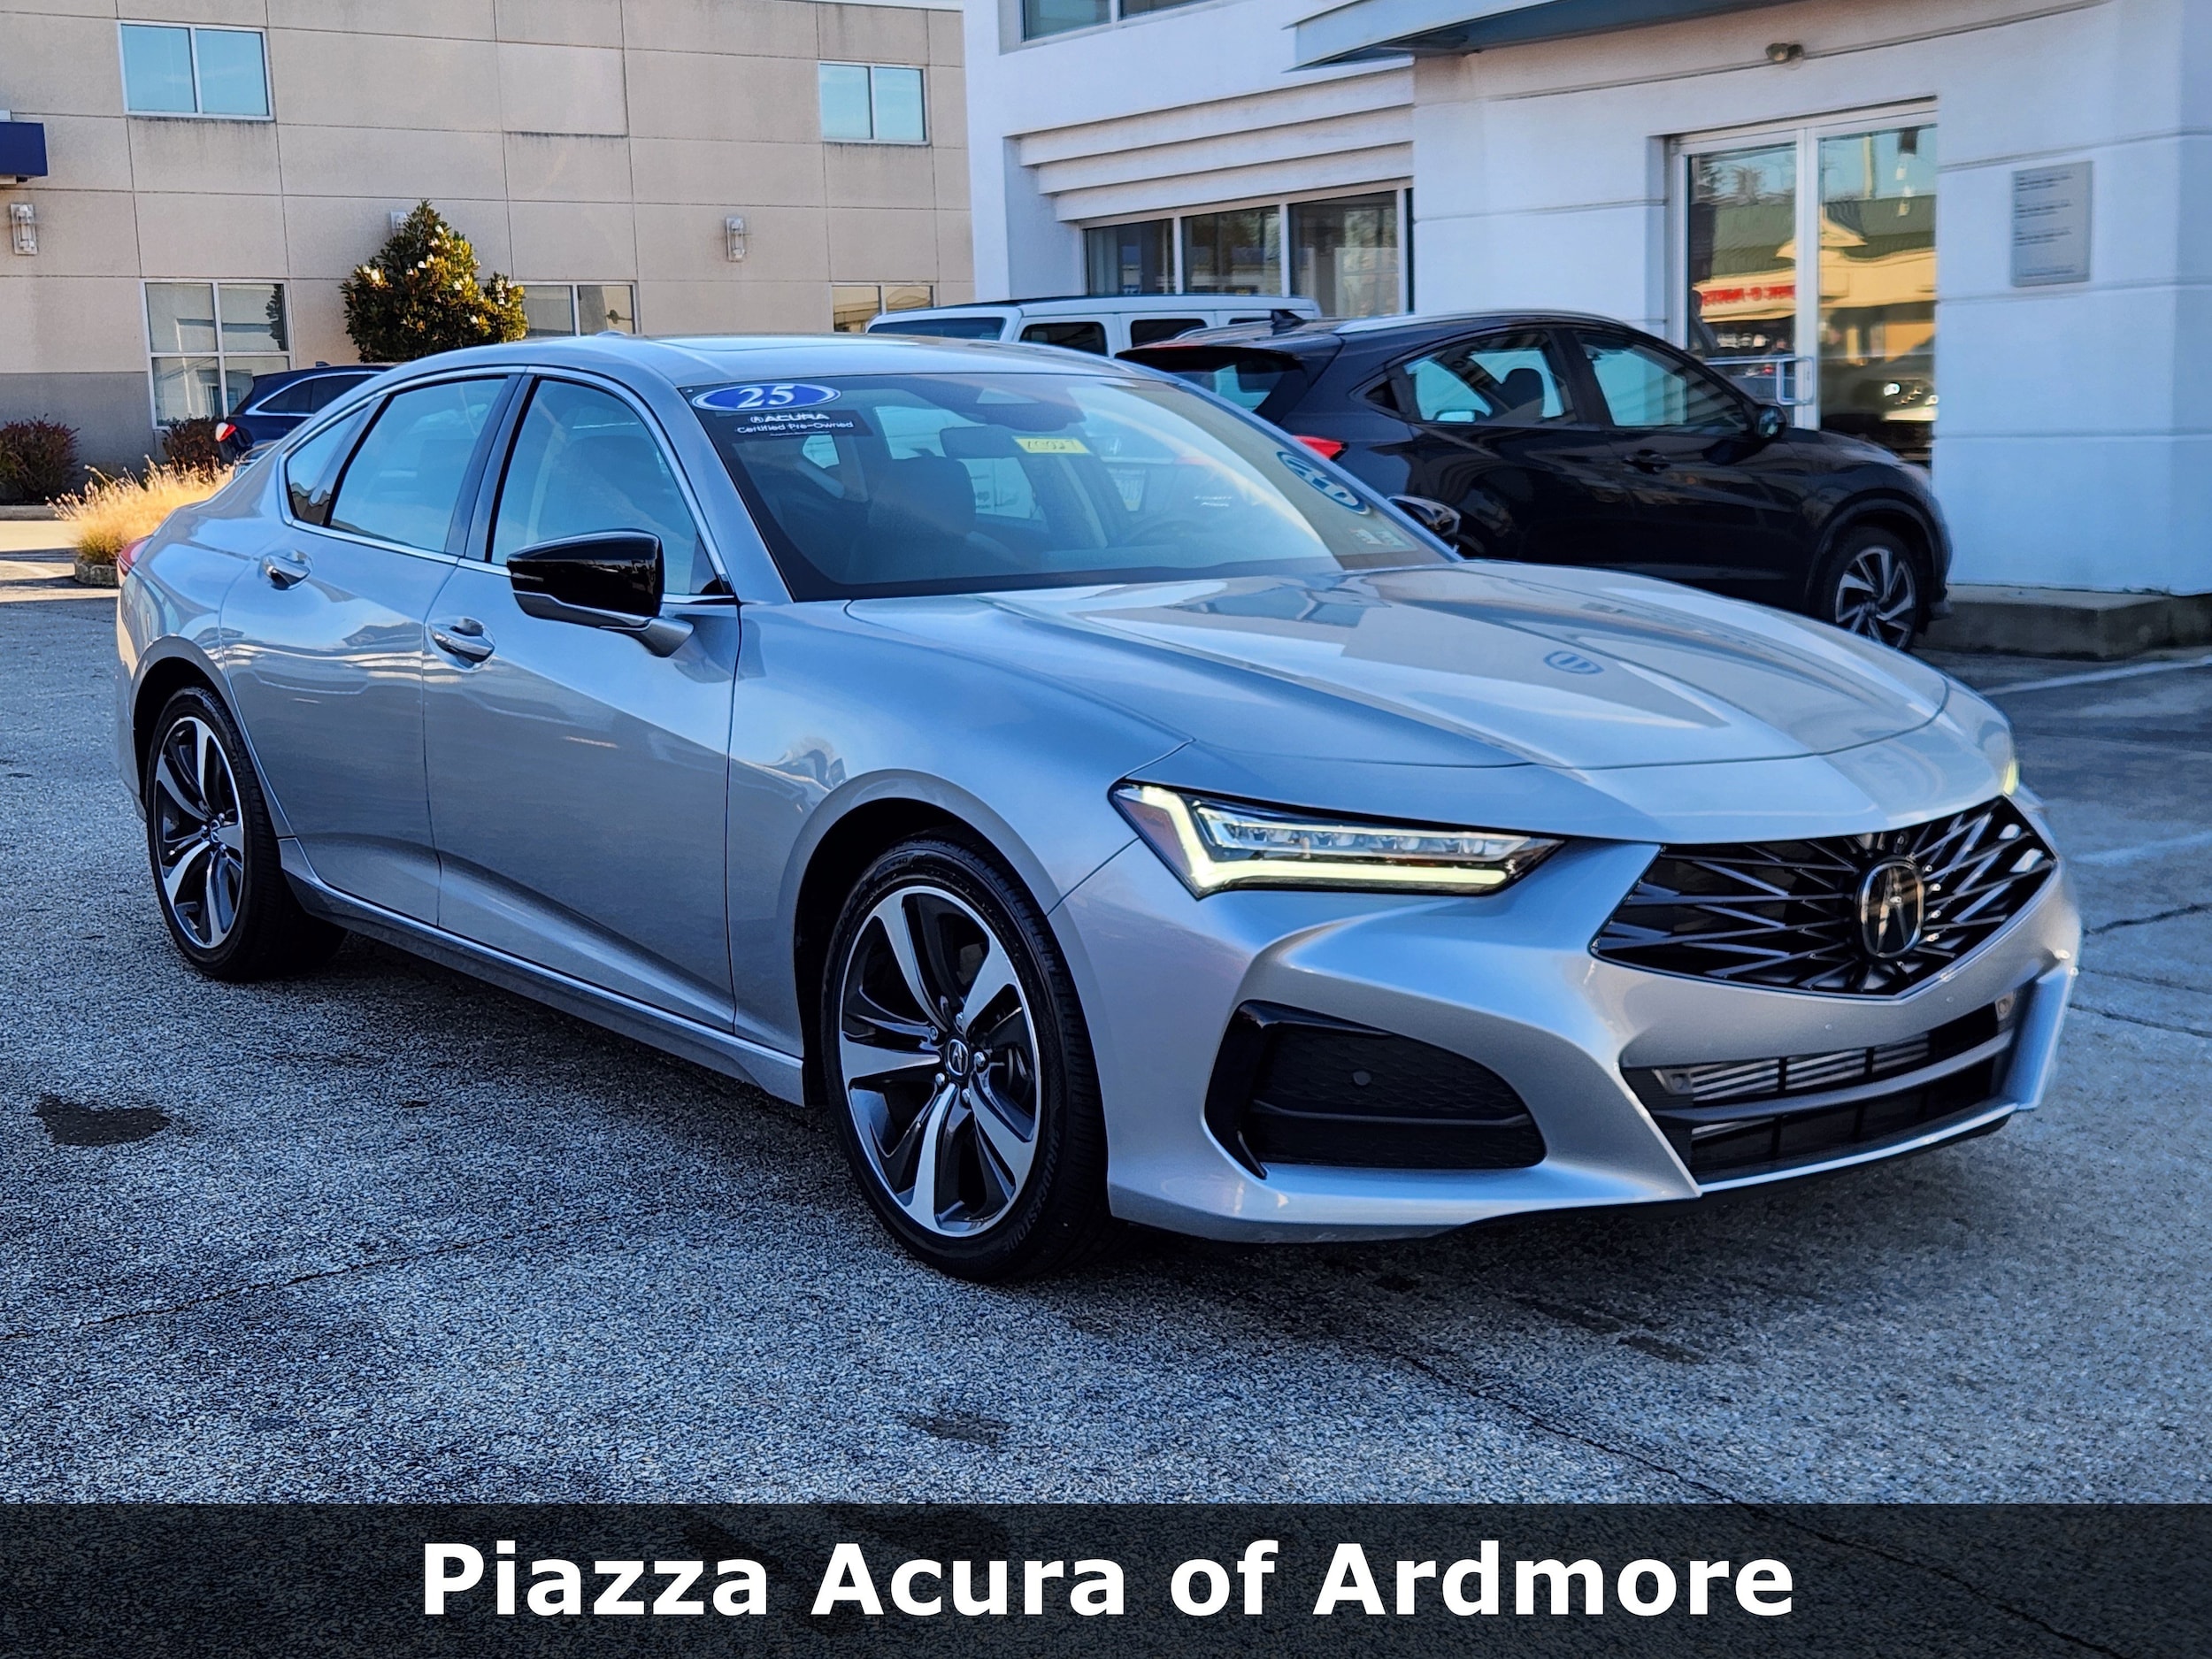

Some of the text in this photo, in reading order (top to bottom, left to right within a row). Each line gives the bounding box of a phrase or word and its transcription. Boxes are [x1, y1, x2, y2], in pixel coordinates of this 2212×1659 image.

[736, 385, 795, 408] 25
[764, 413, 830, 423] ACURA
[736, 422, 786, 434] Certified
[787, 421, 855, 431] Pre-Owned
